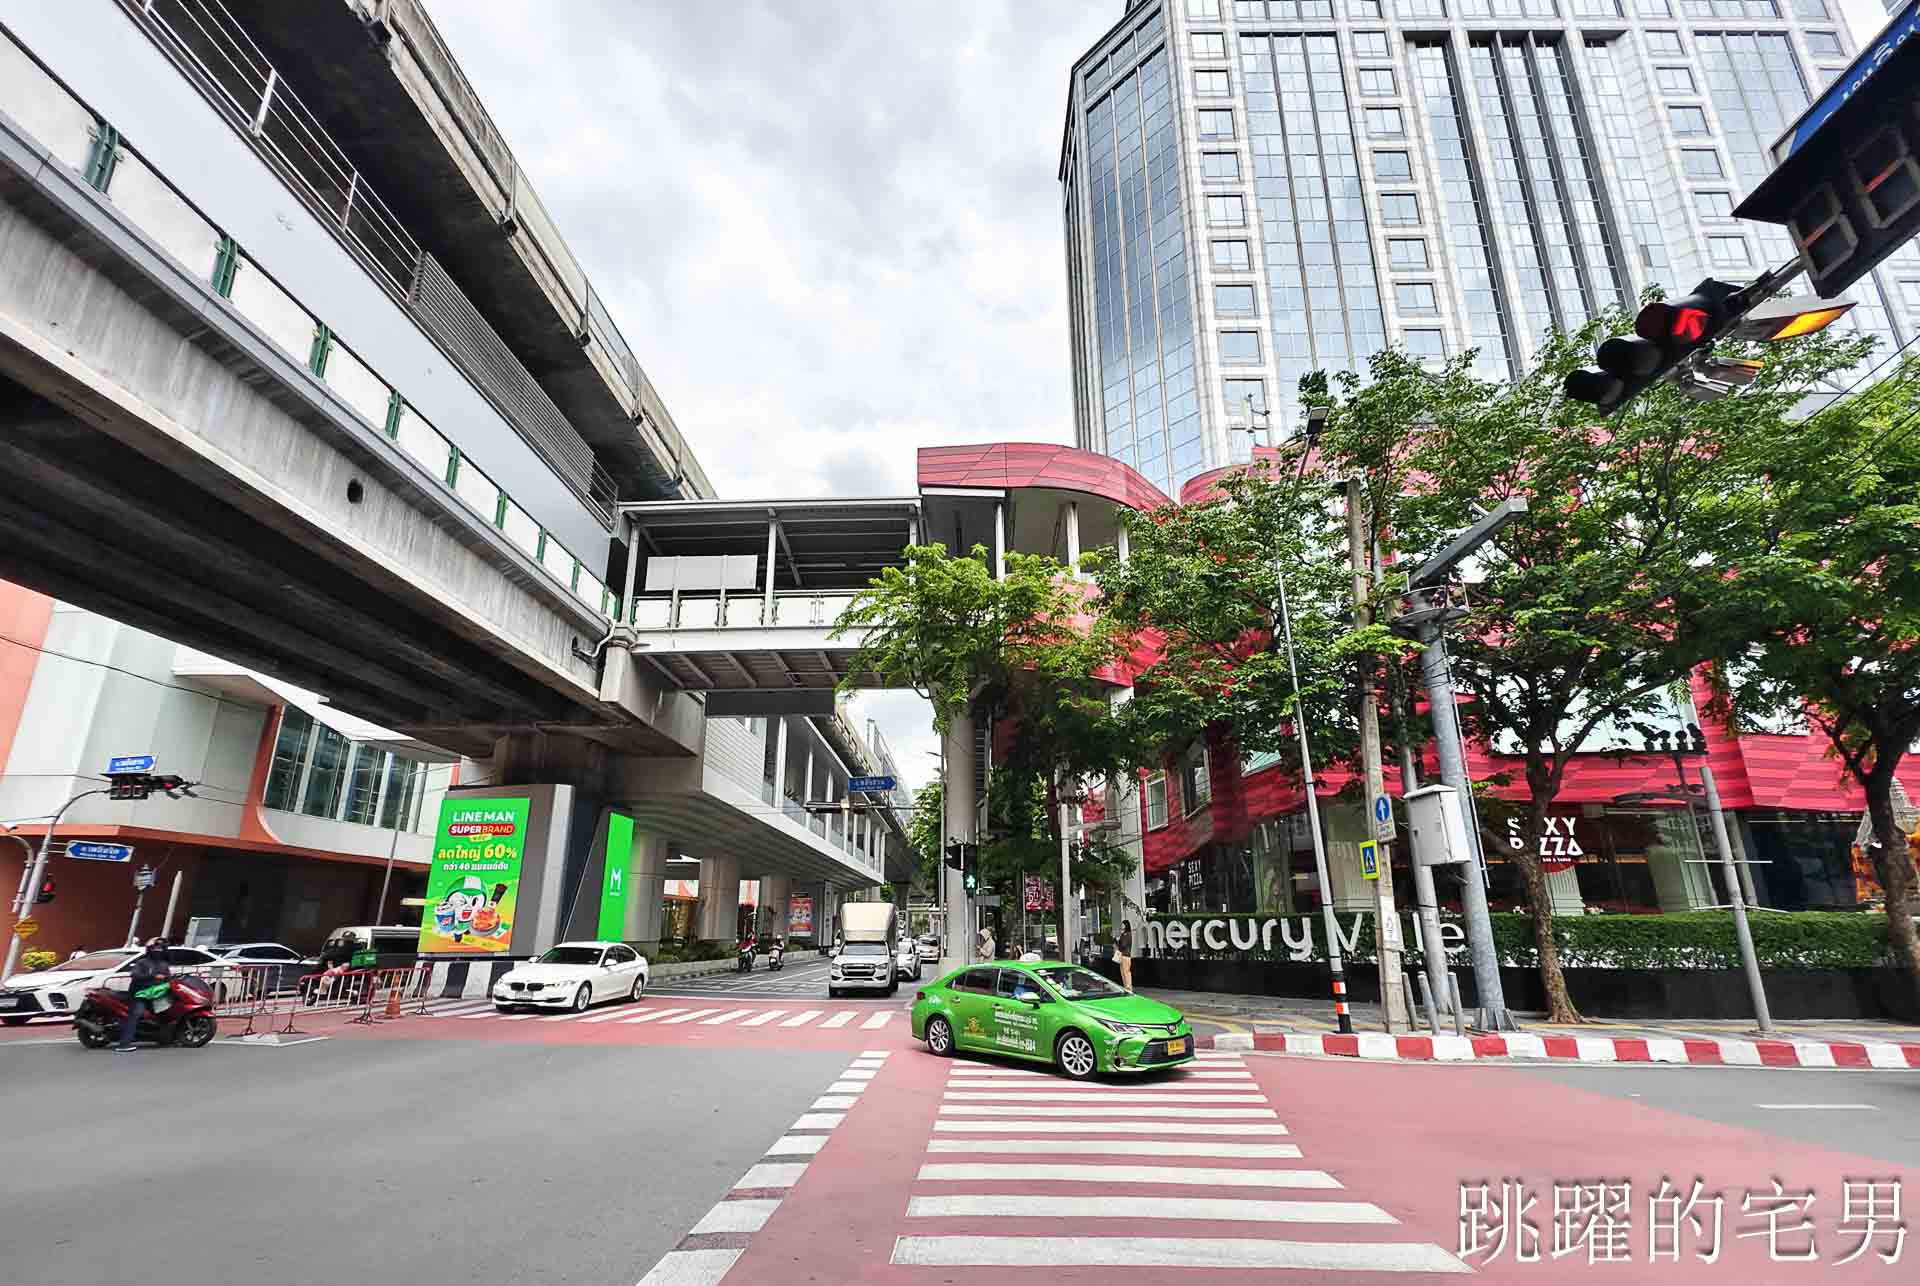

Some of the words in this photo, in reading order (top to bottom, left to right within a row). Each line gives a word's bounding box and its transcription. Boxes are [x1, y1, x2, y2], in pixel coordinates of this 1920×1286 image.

[453, 812, 482, 822] LINE
[484, 812, 514, 822] MAN
[484, 844, 517, 859] 60%
[1133, 917, 1312, 960] mercury
